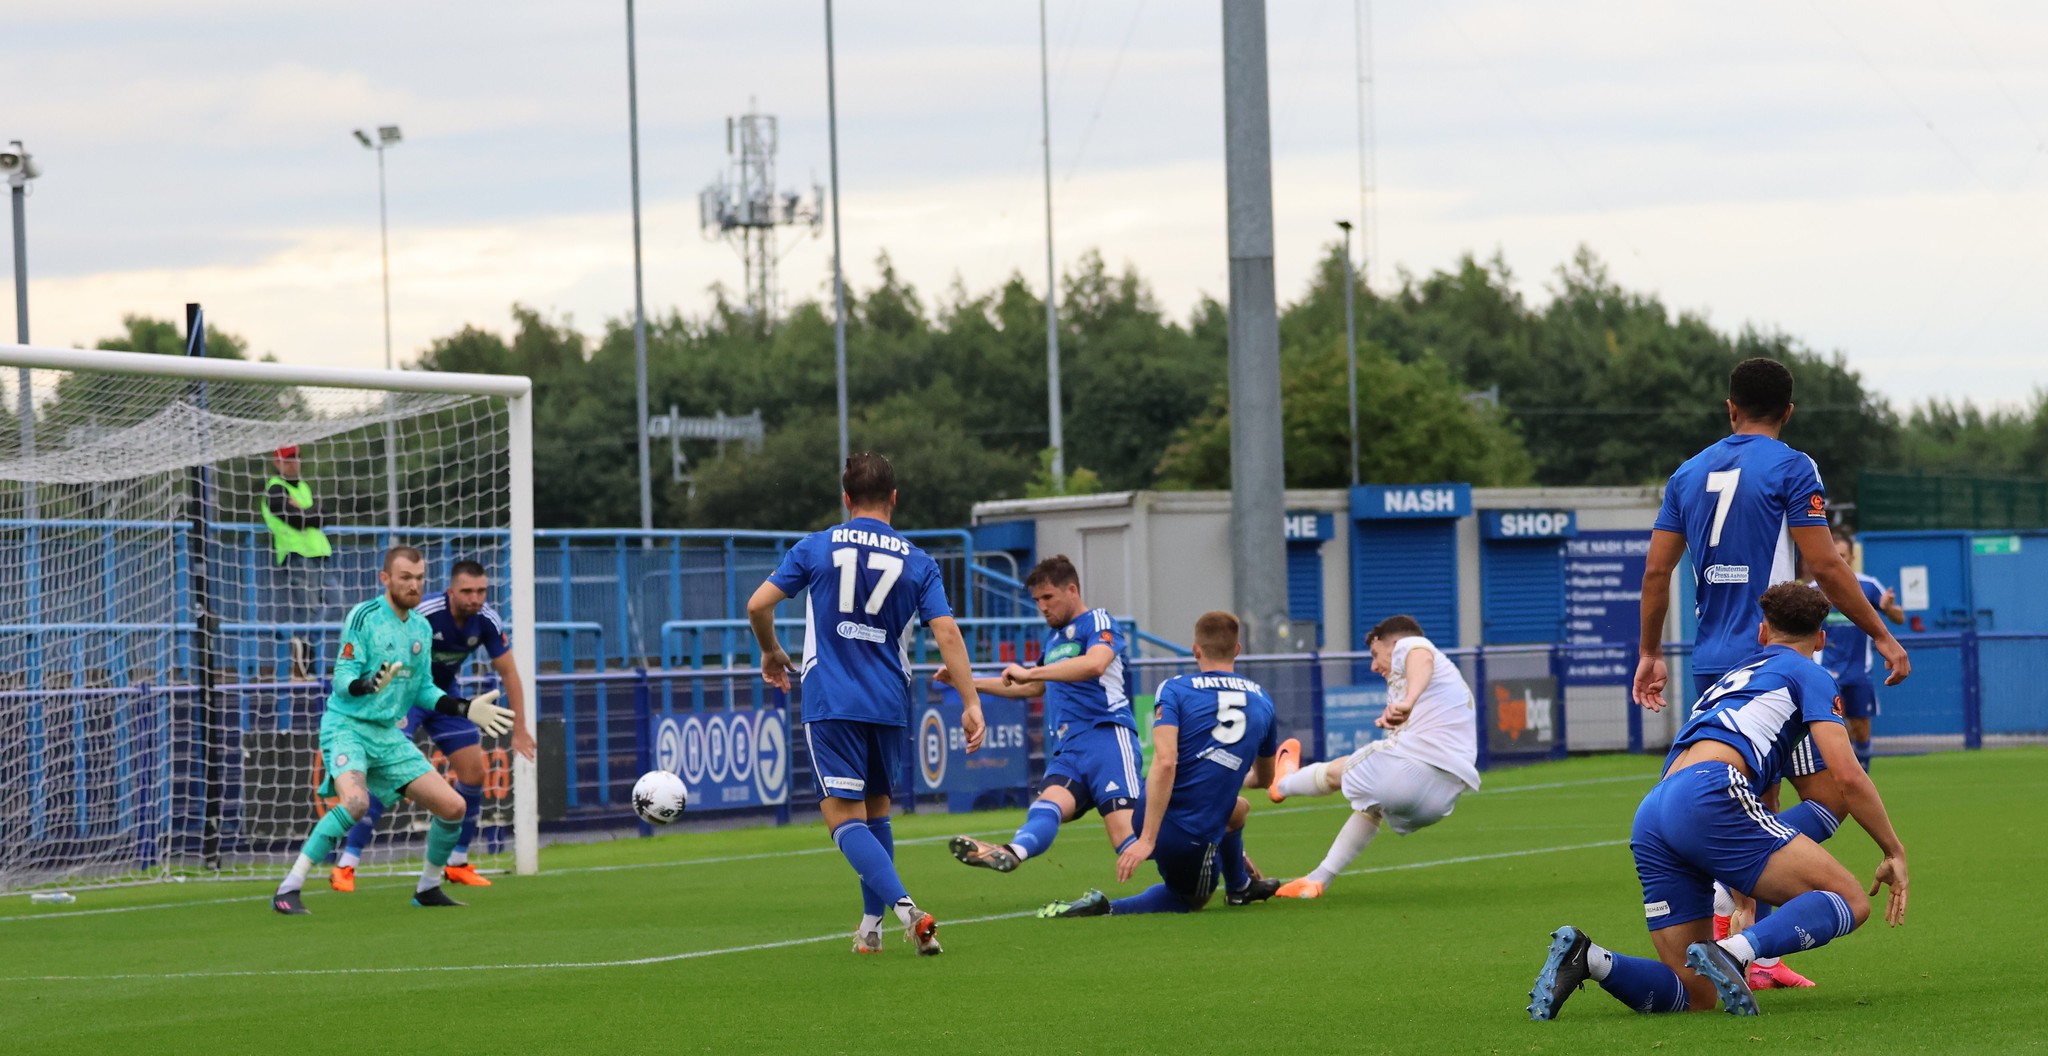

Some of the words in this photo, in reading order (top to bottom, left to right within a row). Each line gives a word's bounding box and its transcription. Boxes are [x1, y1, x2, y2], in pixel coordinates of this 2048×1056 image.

[1285, 515, 1317, 536] HE
[1384, 490, 1455, 513] NASH
[1500, 513, 1569, 535] SHOP
[1706, 468, 1741, 548] 7
[832, 528, 910, 556] RICHARDS
[1567, 541, 1588, 553] THE
[1591, 541, 1622, 553] NASH
[1624, 541, 1650, 553] SHO
[832, 547, 904, 616] 17
[1603, 591, 1643, 601] Merchand
[1211, 690, 1247, 745] 5
